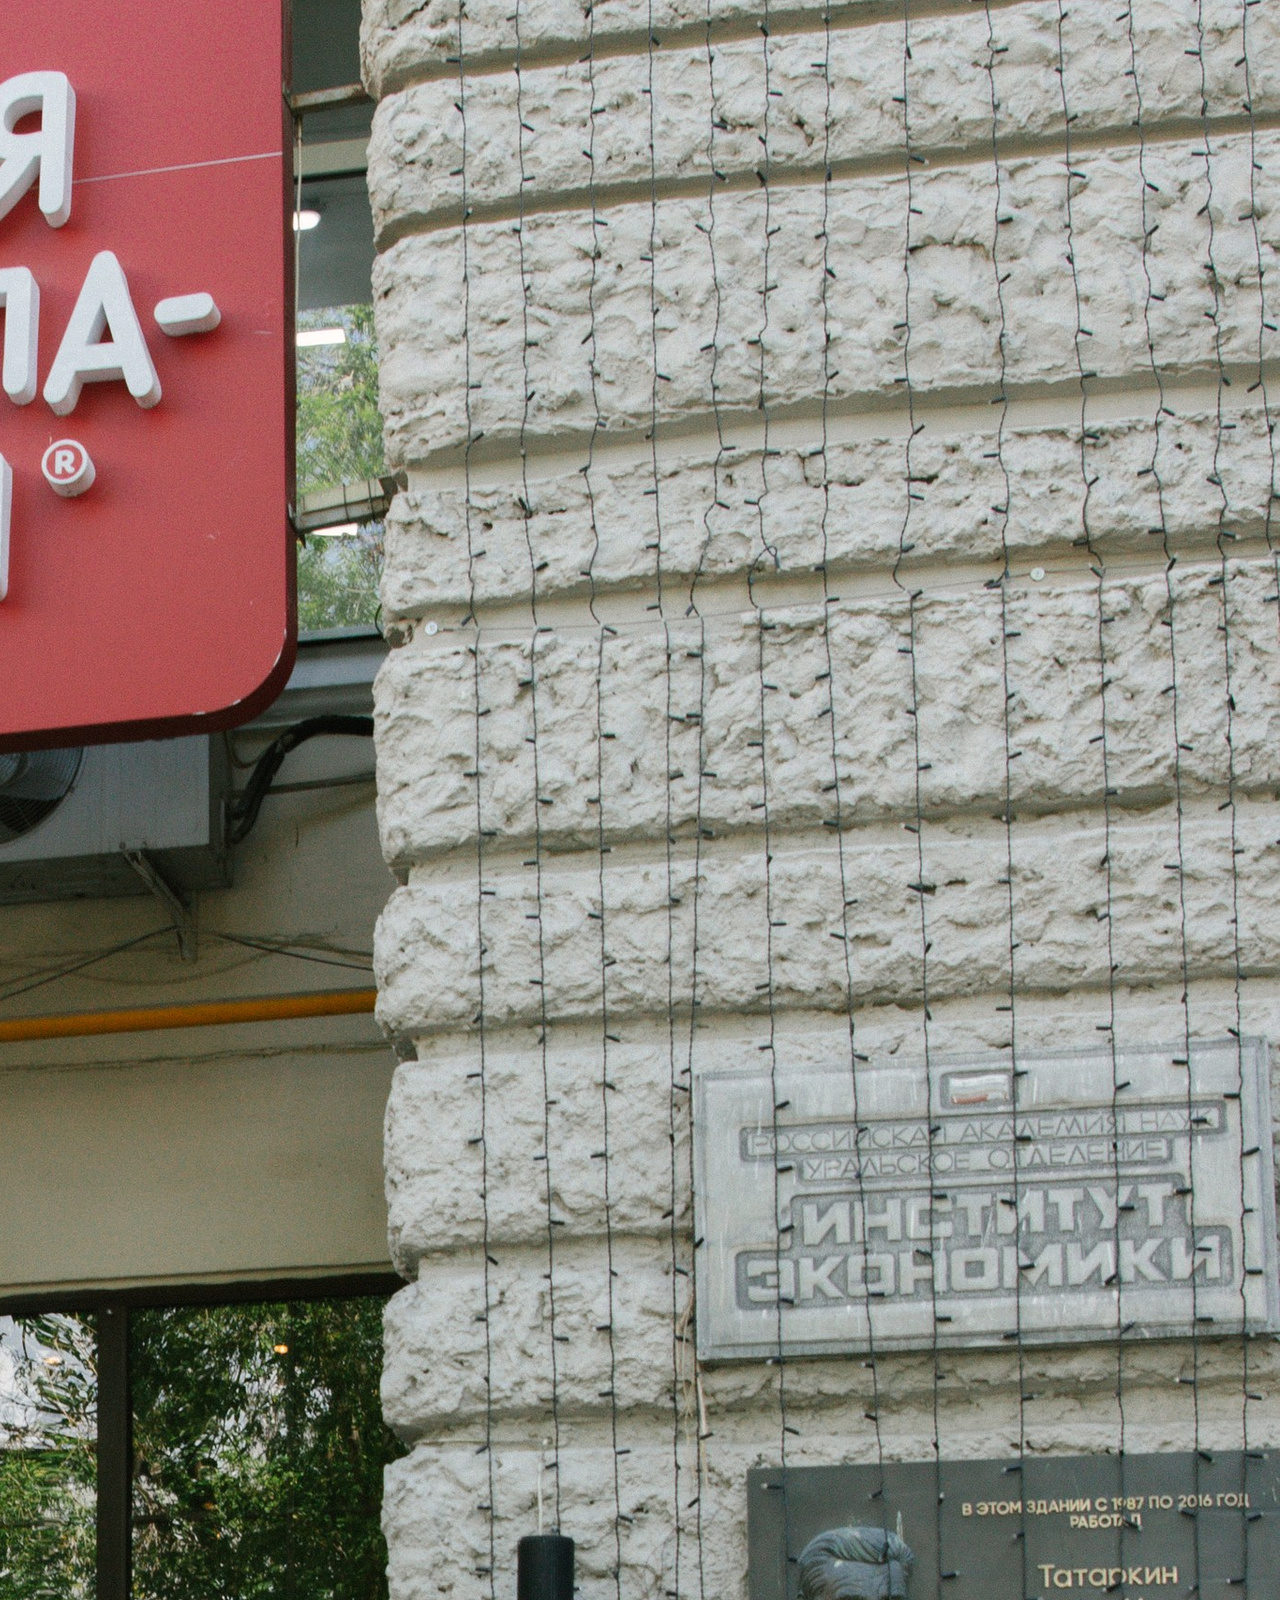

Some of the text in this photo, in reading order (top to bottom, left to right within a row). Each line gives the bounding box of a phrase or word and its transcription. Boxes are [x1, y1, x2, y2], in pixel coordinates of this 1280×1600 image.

[960, 1113, 1126, 1143] АКАДЕМИЯ
[1140, 1107, 1212, 1132] НАУК
[804, 1139, 1163, 1180] УРАЛЬСКОЕ ОТДЕЛЕНИЕ
[802, 1182, 1174, 1246] ИНСТИТУТ
[746, 1234, 1220, 1304] ЭКОНОМИКИ
[962, 1492, 1250, 1516] В ЭТОМ ЗДАНИИ С 1987 ПО 2016 ГОД
[1037, 1563, 1178, 1589] Татаркин
